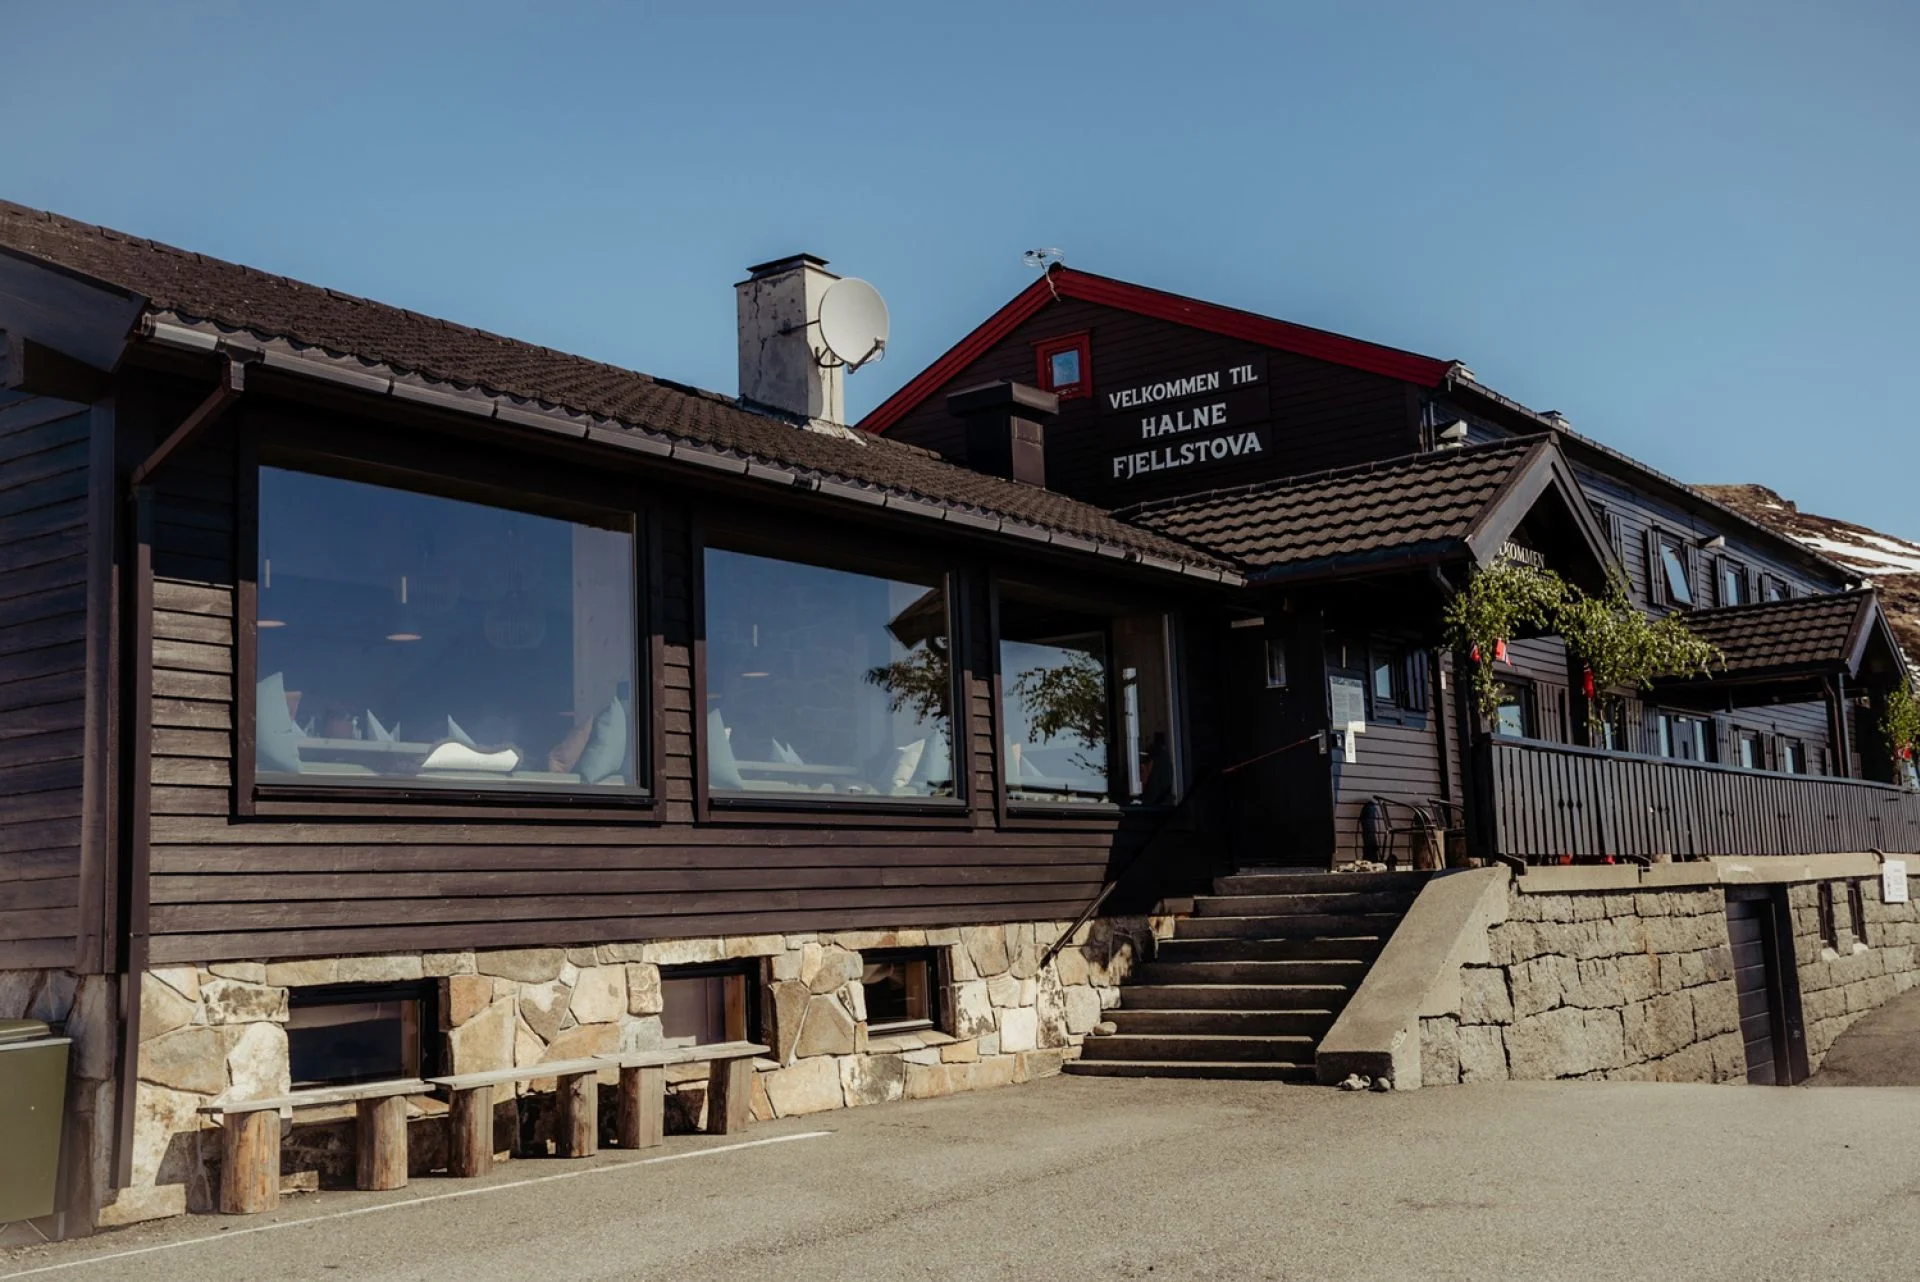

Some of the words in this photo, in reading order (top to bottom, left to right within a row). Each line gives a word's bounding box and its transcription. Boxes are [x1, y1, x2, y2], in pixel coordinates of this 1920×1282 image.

[1109, 371, 1219, 409] VELKOMMEN
[1229, 364, 1258, 385] TIL
[1141, 402, 1227, 439] HALNE
[1113, 431, 1262, 479] FJELLSTOVA
